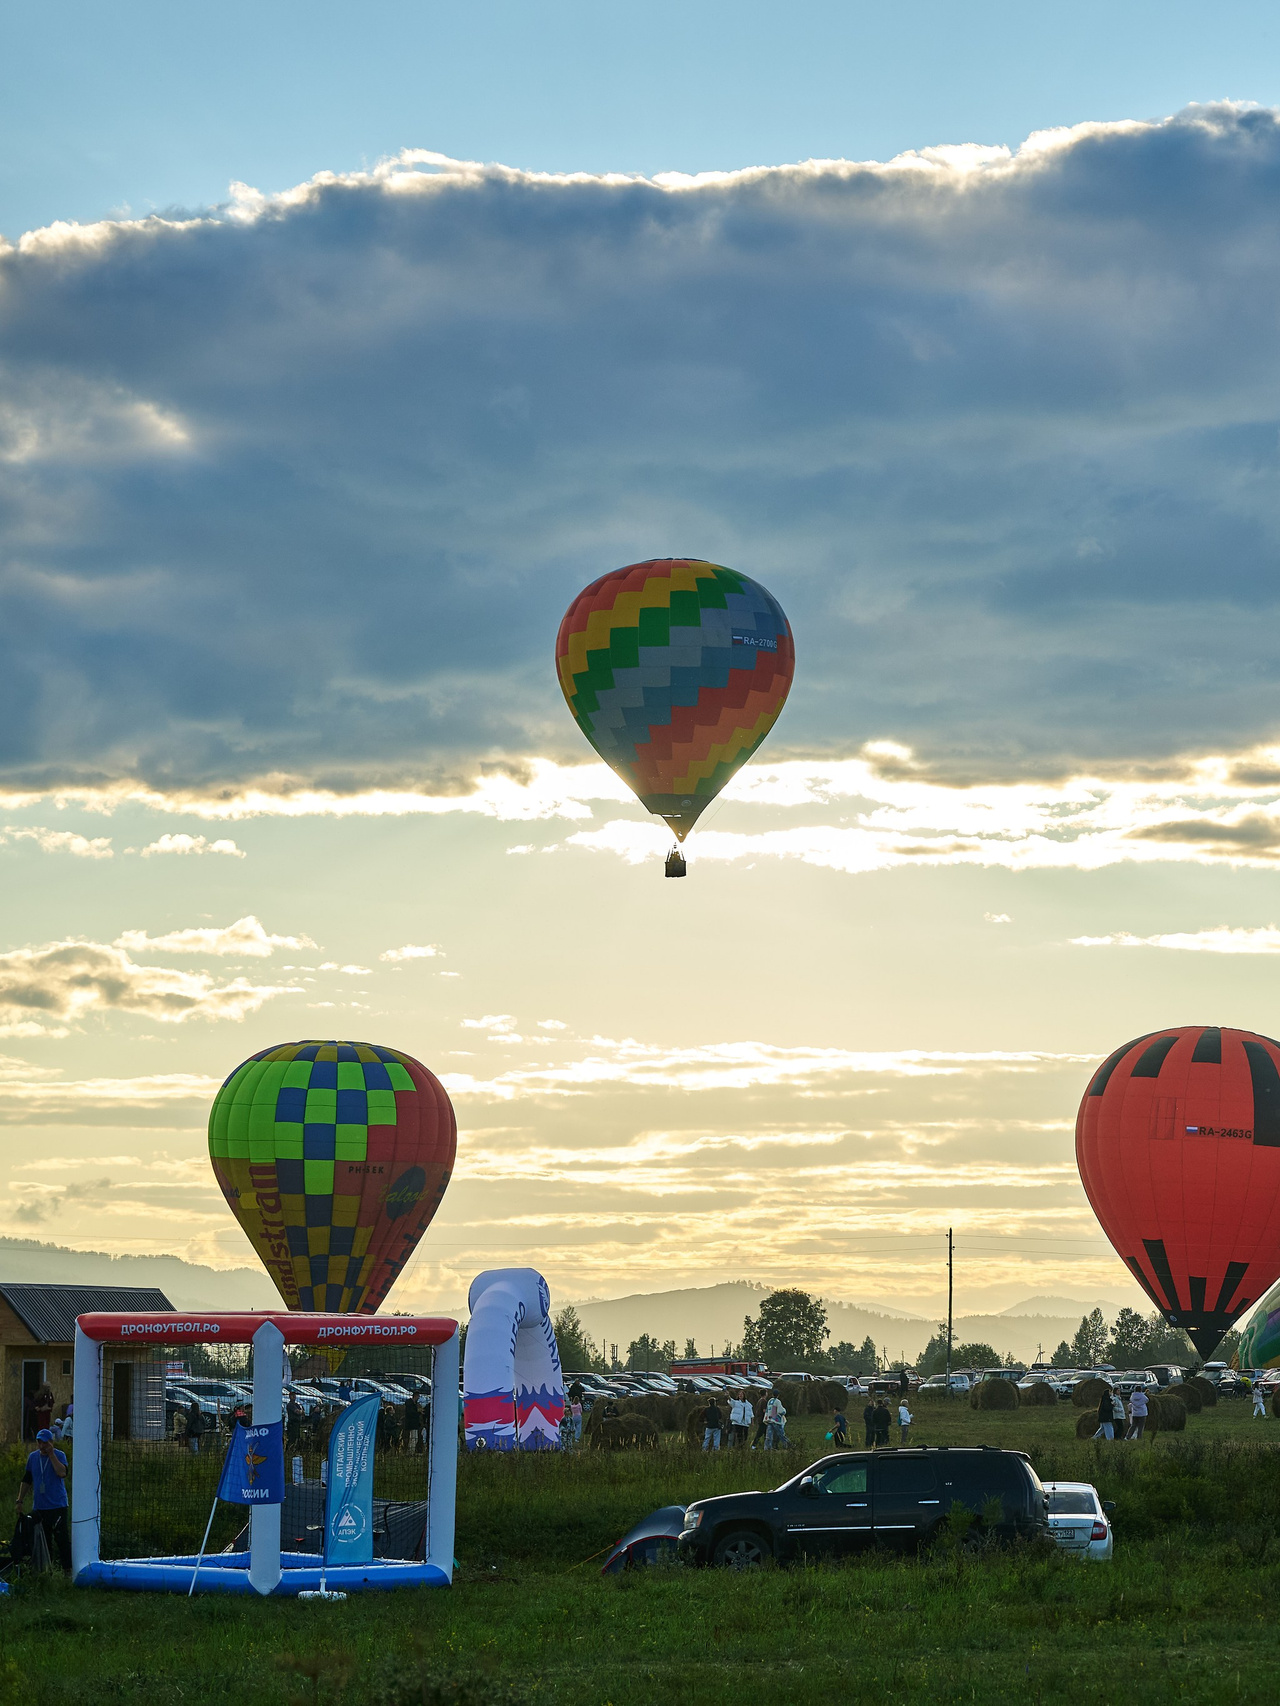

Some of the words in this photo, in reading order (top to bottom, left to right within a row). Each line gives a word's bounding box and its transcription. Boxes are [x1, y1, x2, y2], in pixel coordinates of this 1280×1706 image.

[1199, 1126, 1252, 1139] RA-2463G
[121, 1322, 220, 1335] ДРОНФУТБОЛ.РФ
[317, 1325, 417, 1338] ДРОНФУТБОЛ.РФ
[335, 1432, 346, 1478] АЛТАЙСКИЙ
